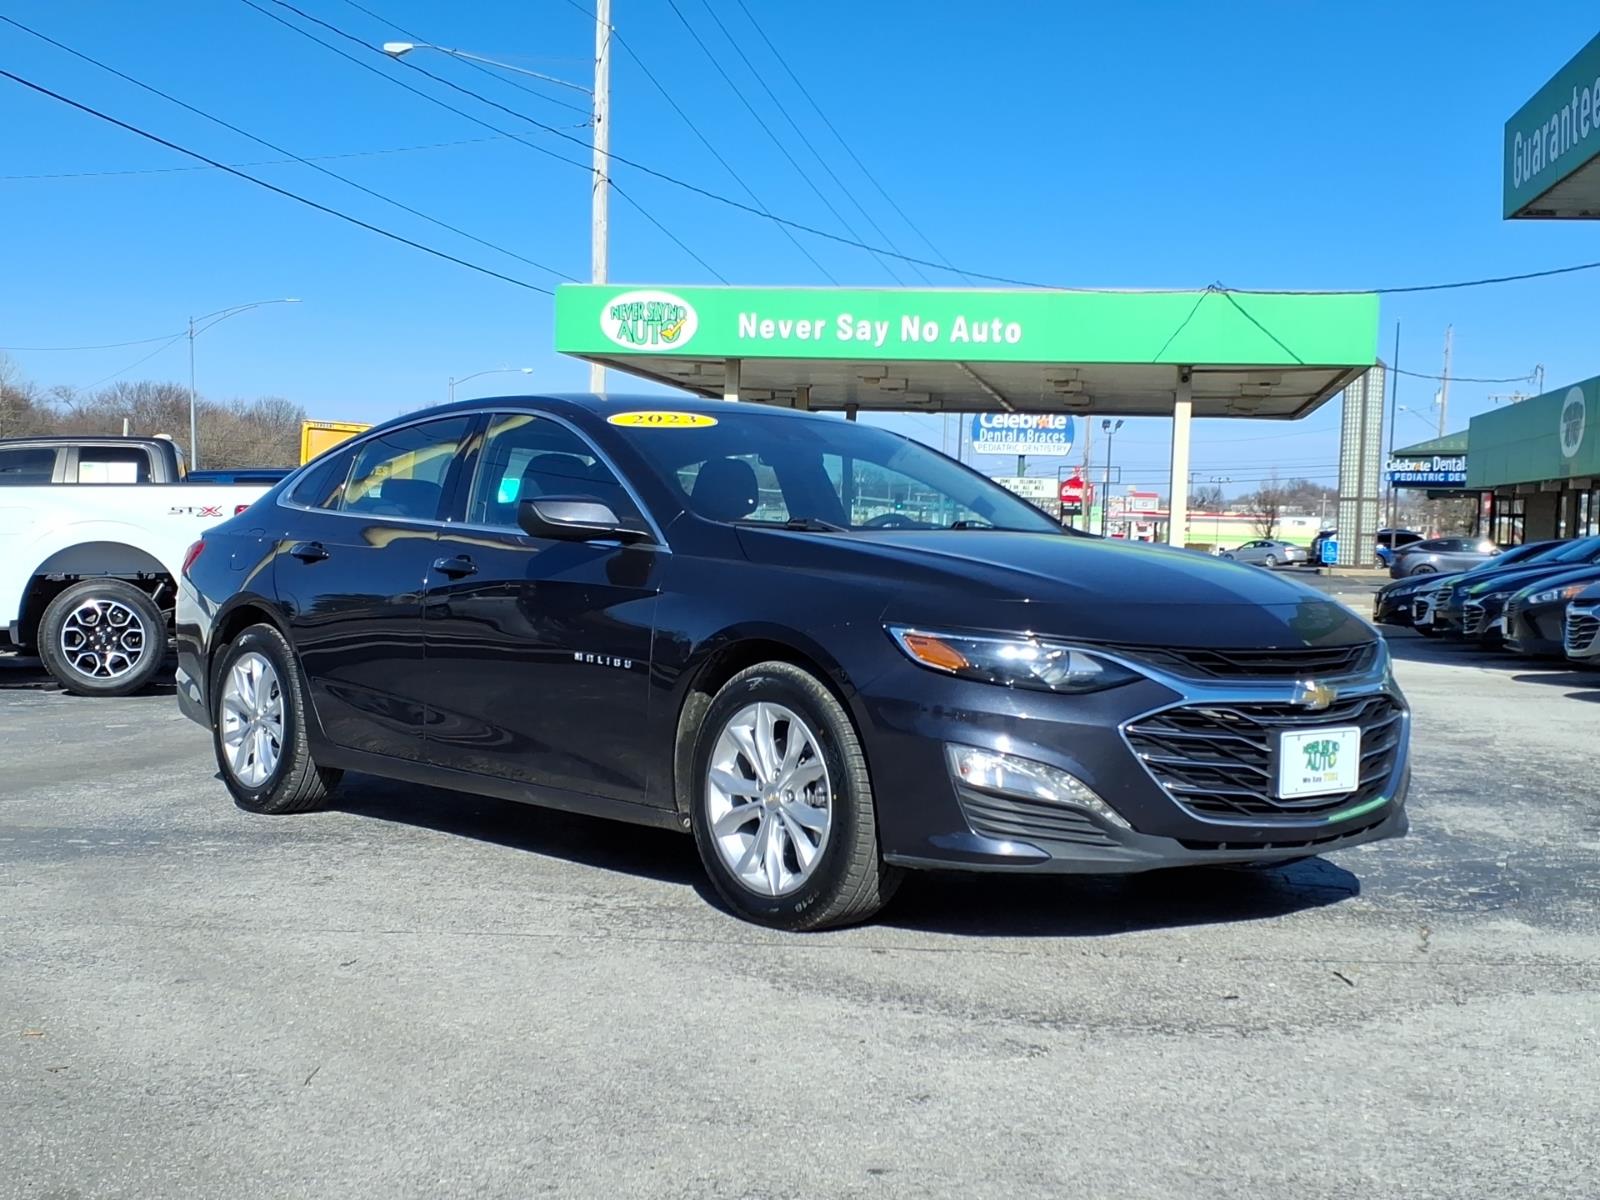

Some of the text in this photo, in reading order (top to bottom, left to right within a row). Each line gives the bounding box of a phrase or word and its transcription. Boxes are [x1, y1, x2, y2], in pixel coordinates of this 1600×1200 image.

[610, 301, 646, 321] NEVER
[646, 300, 668, 321] SAY
[617, 319, 682, 345] AUTO
[738, 311, 1022, 348] Never Say No Auto
[980, 428, 1017, 443] Dental
[1026, 429, 1066, 443] Braces
[978, 443, 1067, 453] PEDIATRIC DENTISTRY
[1433, 456, 1466, 471] Dental
[1394, 472, 1445, 481] PEDIATRIC
[1305, 751, 1337, 772] AUTO
